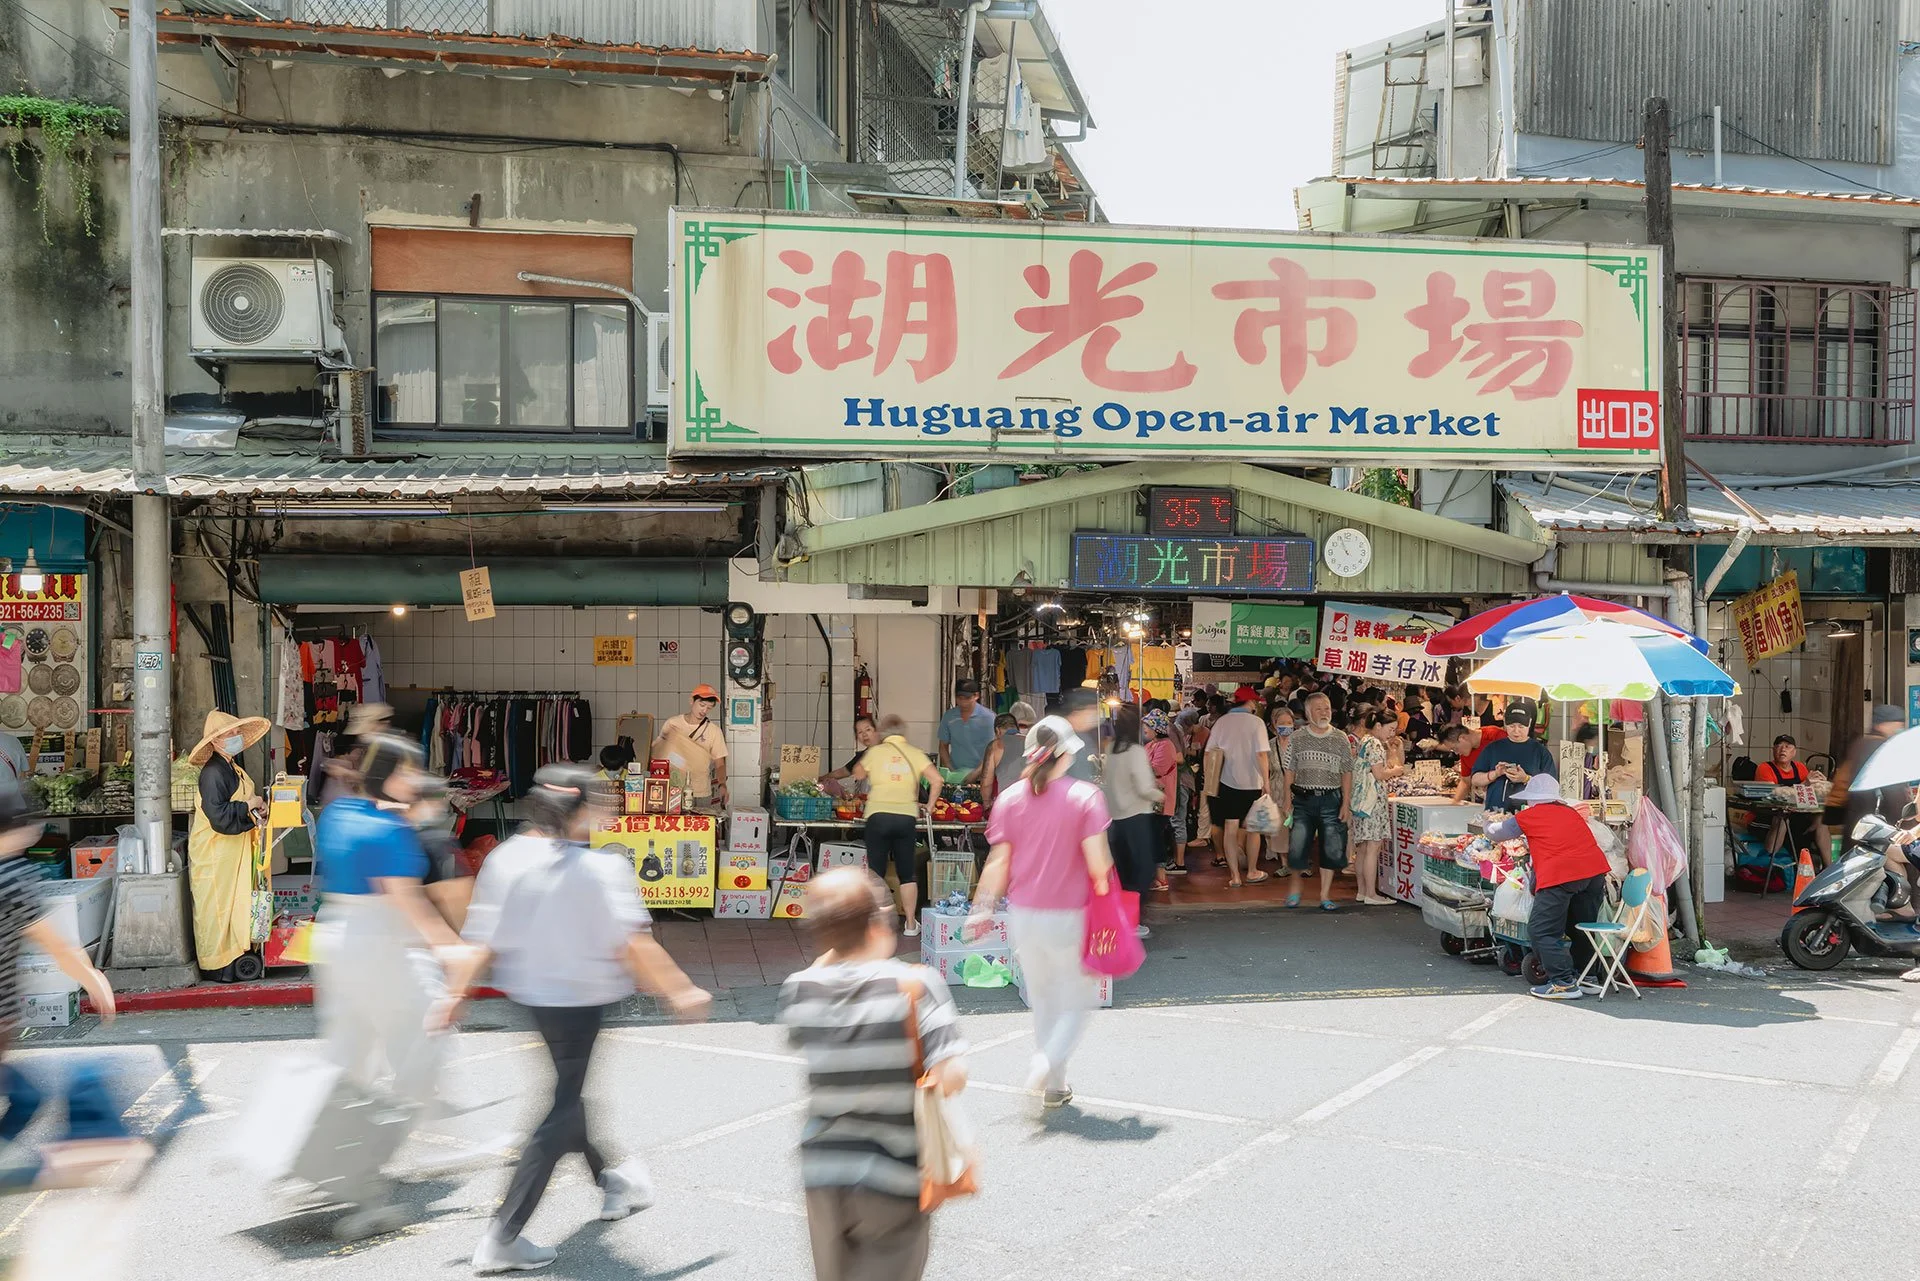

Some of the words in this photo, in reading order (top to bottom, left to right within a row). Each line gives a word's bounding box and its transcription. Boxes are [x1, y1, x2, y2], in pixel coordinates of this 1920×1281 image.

[766, 249, 1584, 400] 湖光市場
[843, 397, 1083, 438] Huguang
[1092, 401, 1318, 438] Open-air
[1328, 405, 1501, 437] Market
[1582, 397, 1655, 440] 出口B
[1164, 497, 1202, 528] 35
[1096, 540, 1289, 588] 湖光市場
[1322, 647, 1442, 683] 草湖芋仔冰
